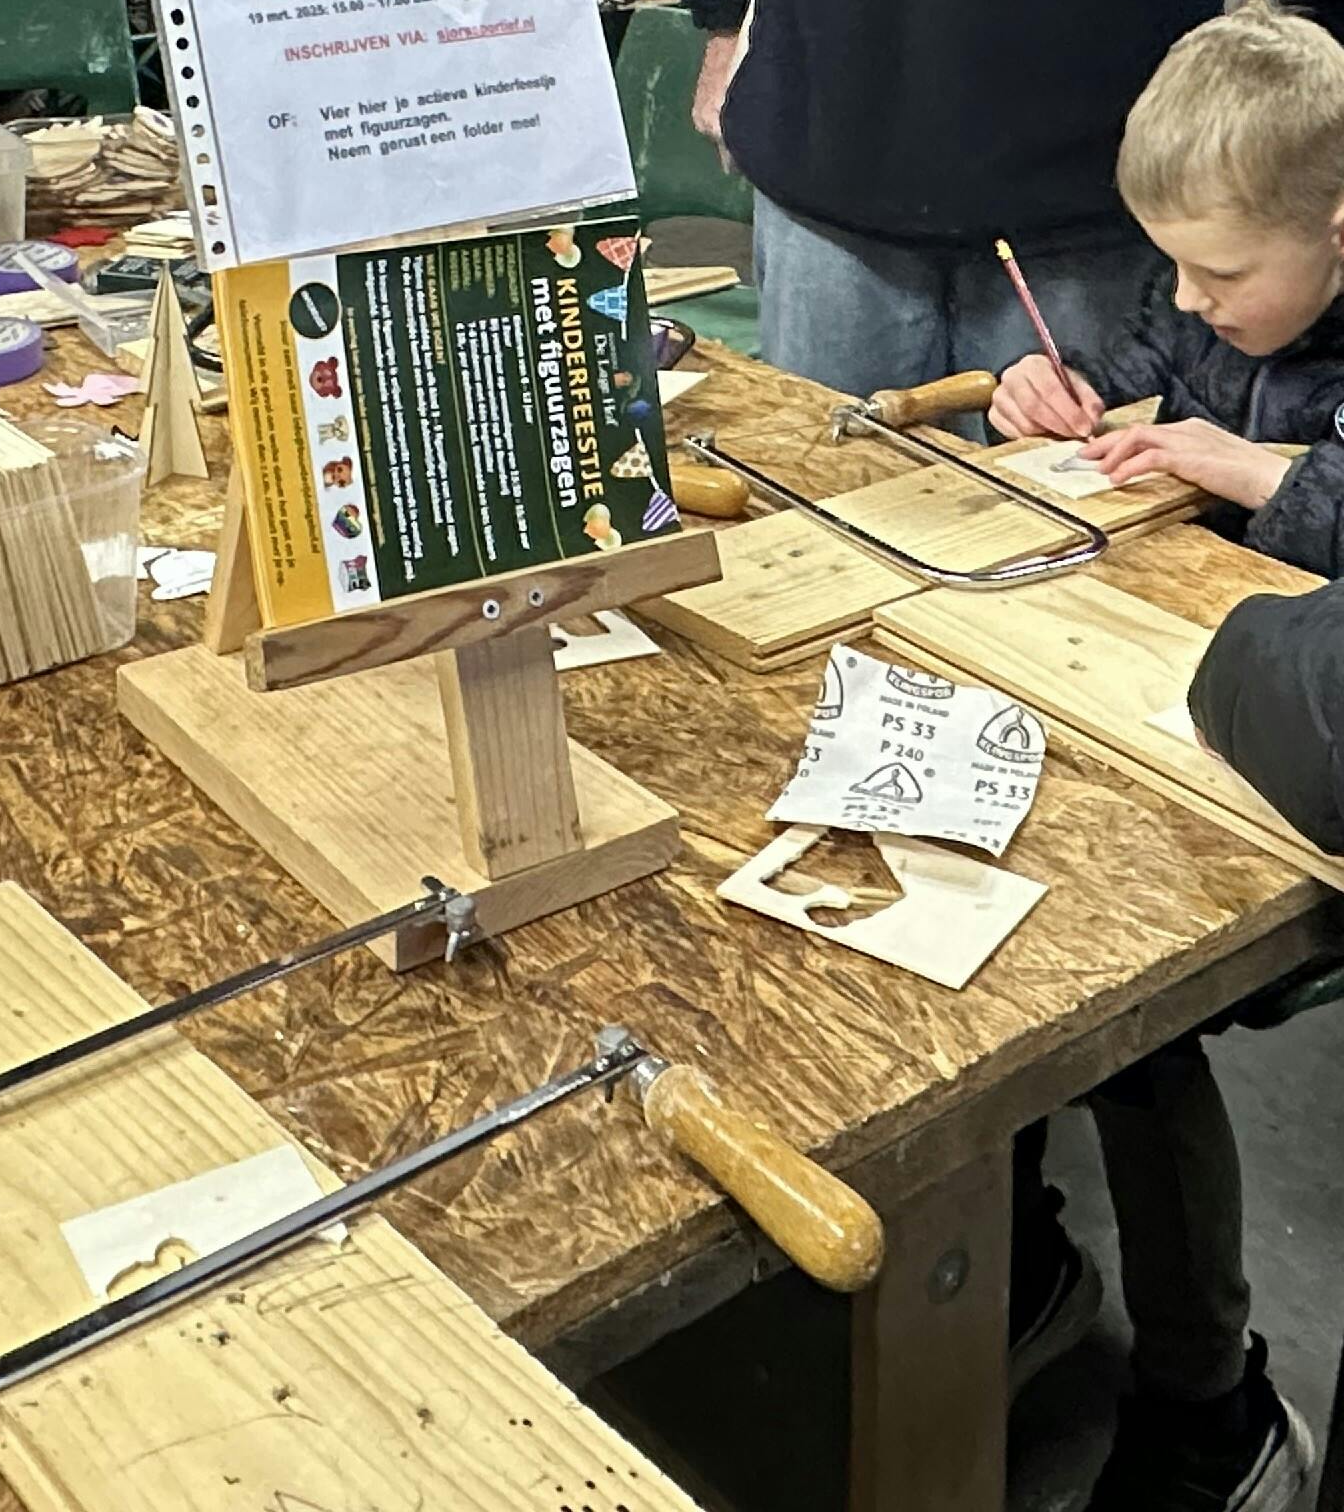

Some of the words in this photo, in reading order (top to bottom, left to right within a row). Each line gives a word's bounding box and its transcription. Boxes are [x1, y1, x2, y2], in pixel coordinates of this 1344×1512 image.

[332, 0, 364, 14] 15.00
[284, 36, 390, 62] INSCHRIJVEN
[397, 29, 428, 46] VIA:
[268, 114, 297, 130] OF:
[319, 104, 350, 121] Vier
[358, 100, 387, 116] hier
[395, 96, 409, 112] je
[417, 87, 468, 106] actieve
[474, 74, 557, 97] kinderfeestje
[324, 126, 354, 141] met
[360, 110, 451, 137] figuurzagen.
[328, 145, 370, 162] Neem
[380, 136, 426, 156] gerust
[430, 131, 456, 144] een
[463, 122, 504, 138] folder
[511, 114, 541, 131] mee!
[529, 276, 559, 334] met
[555, 276, 605, 500] KINDERFEESTJE
[593, 333, 608, 361] De
[603, 397, 619, 427] Hof
[535, 339, 578, 509] figuurzagen
[879, 695, 903, 707] MADE
[905, 701, 915, 709] IN
[881, 712, 905, 733] PS
[911, 720, 936, 740] 33
[880, 740, 891, 753] P
[894, 744, 924, 762] 240
[974, 778, 999, 795] PS
[1005, 784, 1031, 800] 33
